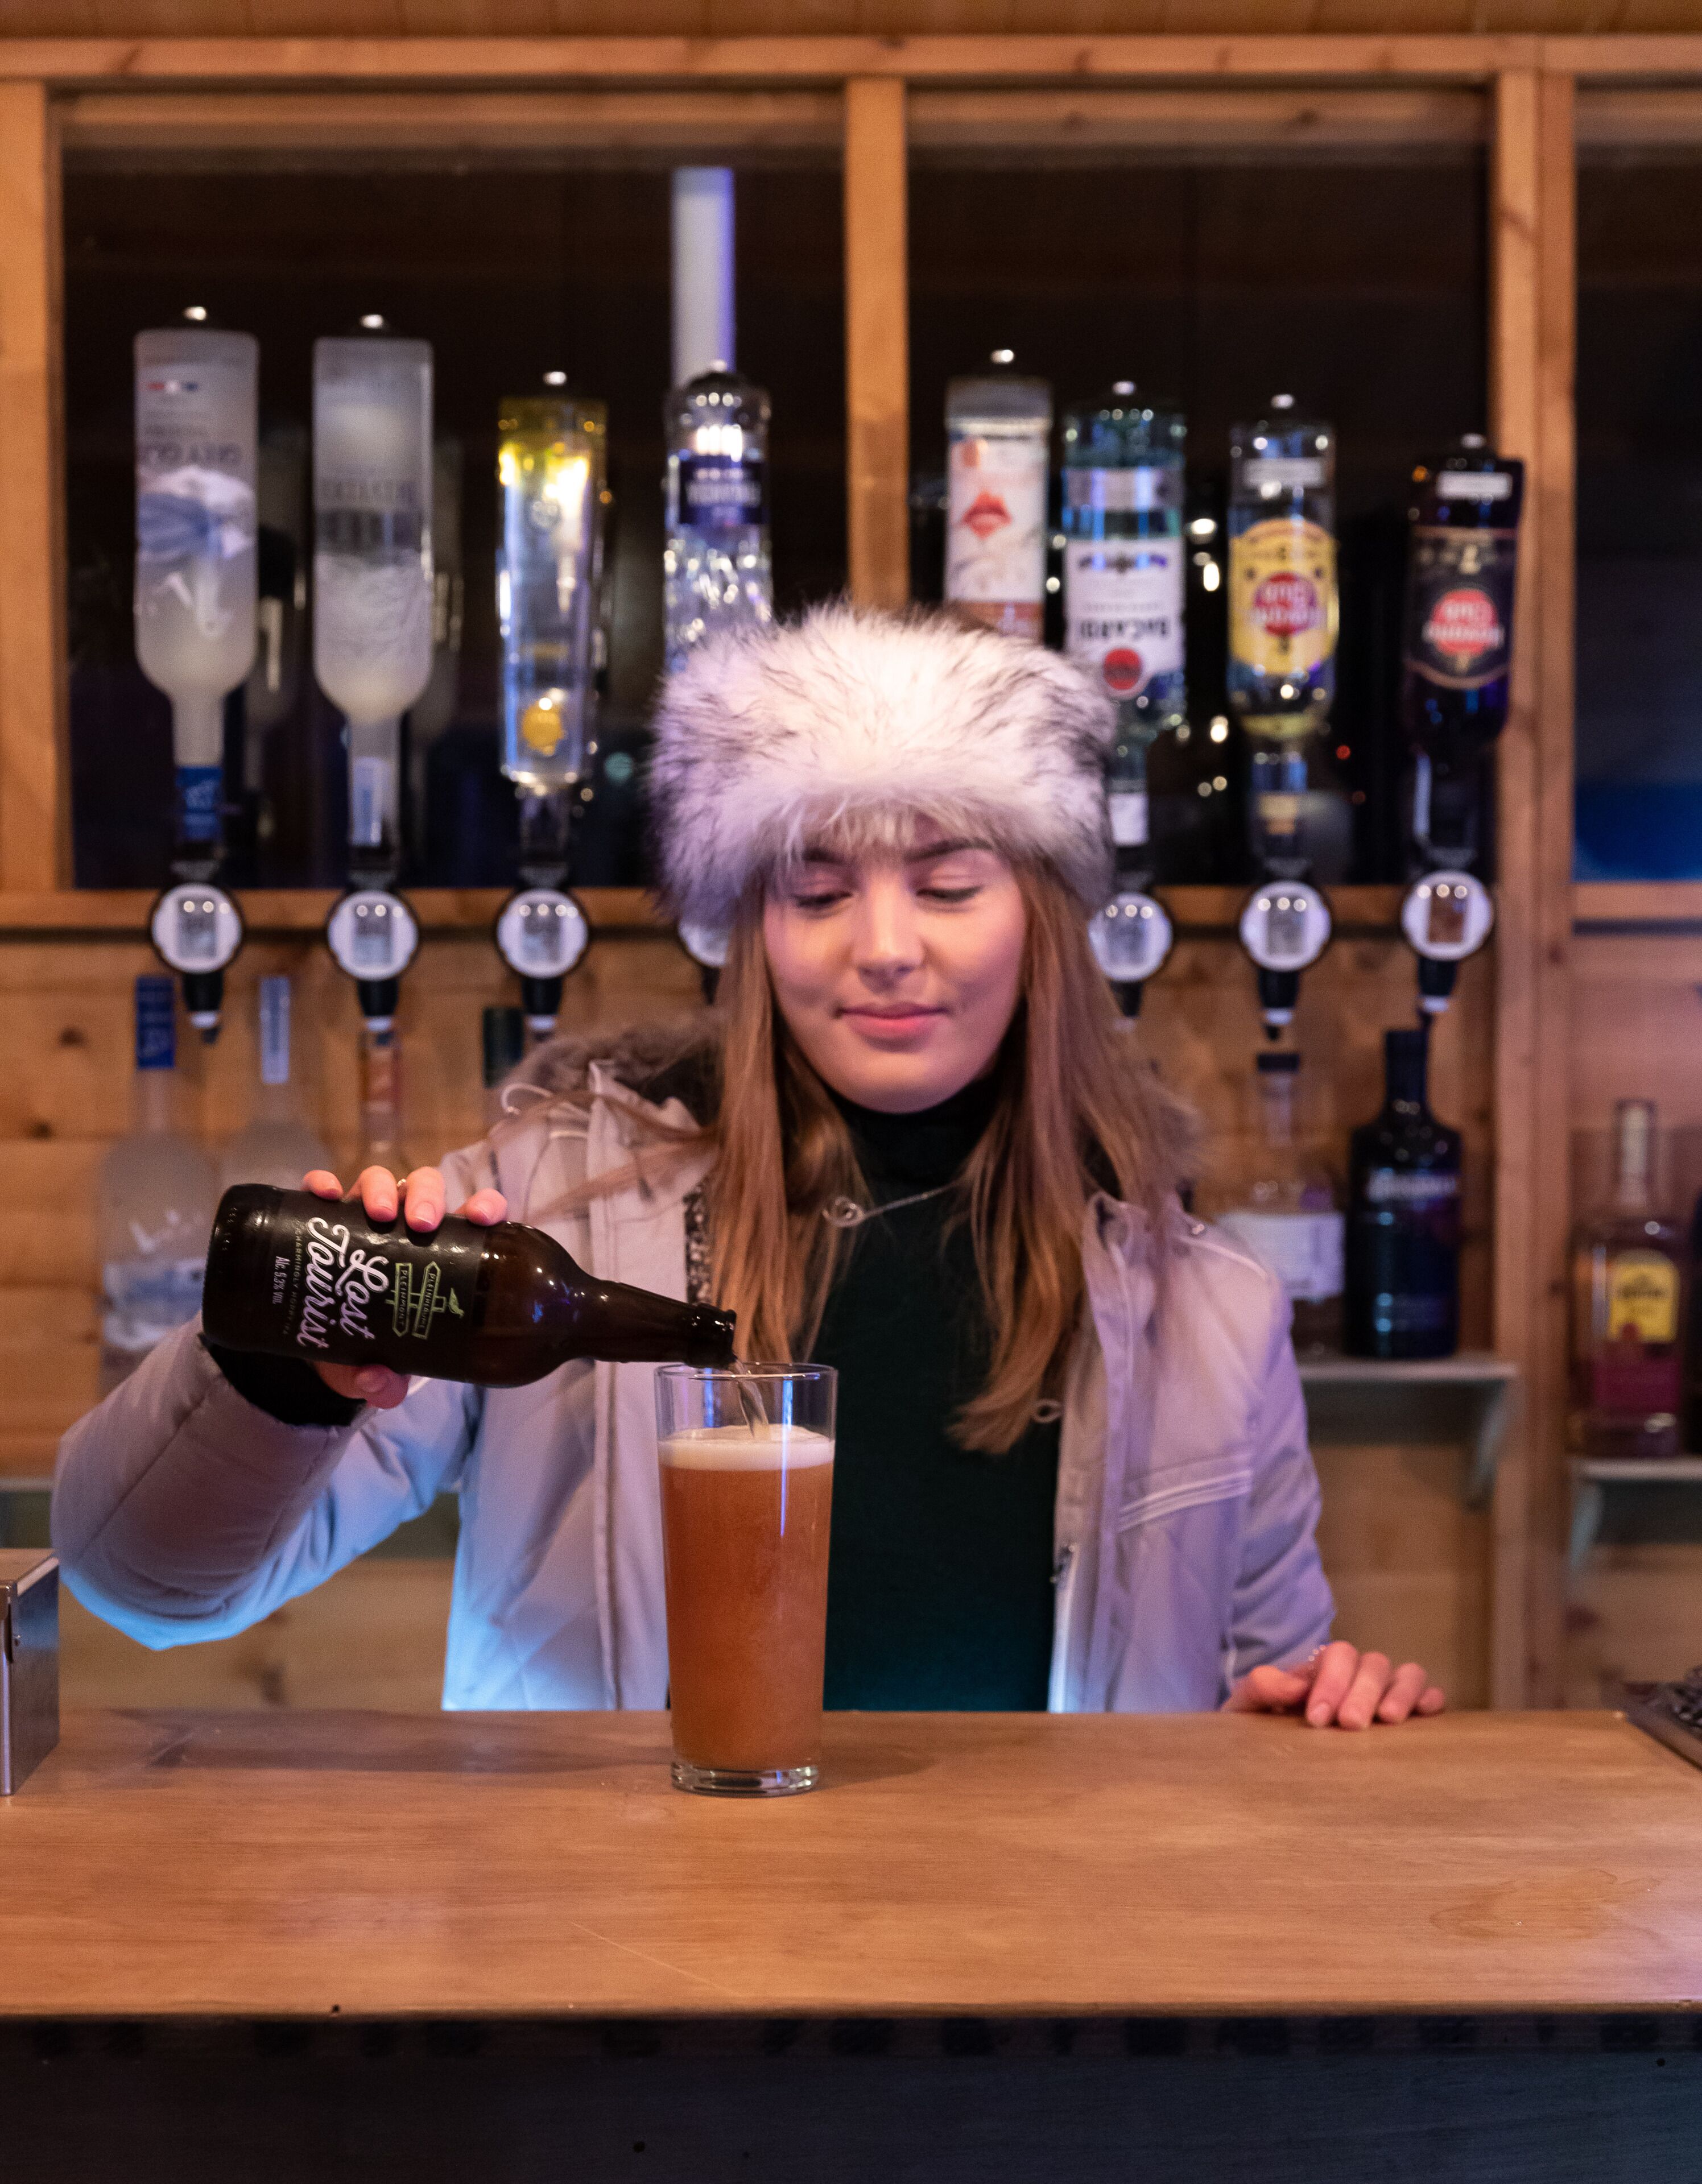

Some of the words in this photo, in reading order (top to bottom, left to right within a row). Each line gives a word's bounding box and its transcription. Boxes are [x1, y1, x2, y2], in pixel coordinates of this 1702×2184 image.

[275, 1256, 291, 1270] Alc.
[292, 1230, 303, 1288] CHARMINGLY
[296, 1217, 350, 1349] Tourist
[335, 1249, 390, 1339] Lost
[398, 1269, 408, 1326] PLEINMONT
